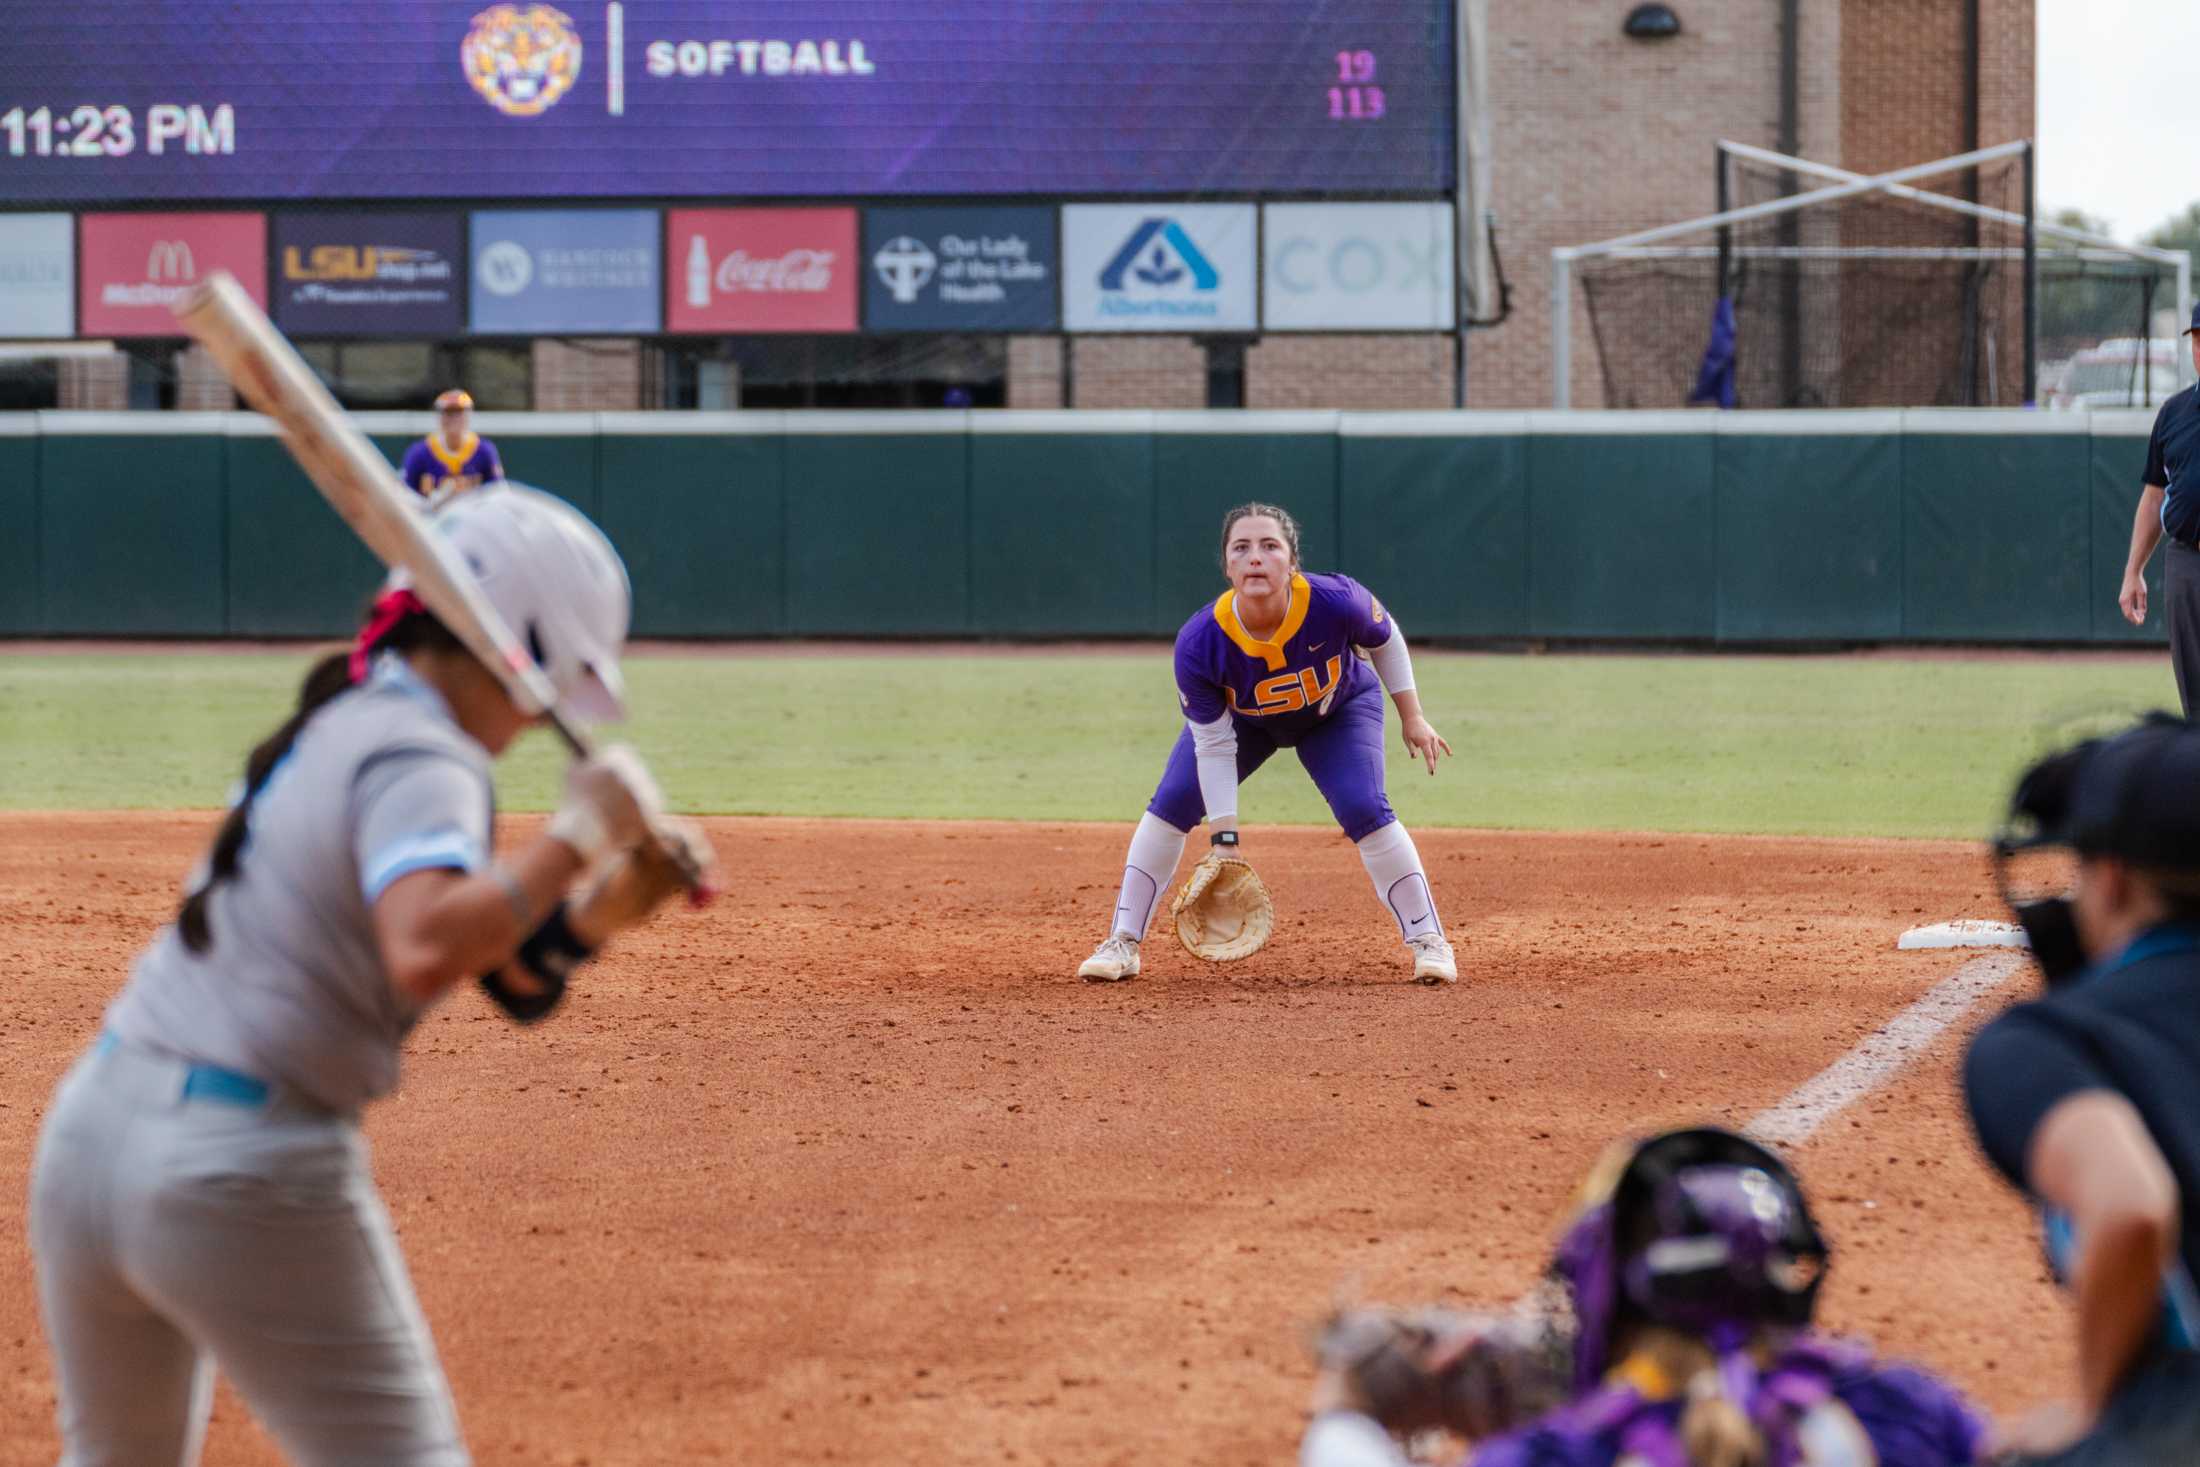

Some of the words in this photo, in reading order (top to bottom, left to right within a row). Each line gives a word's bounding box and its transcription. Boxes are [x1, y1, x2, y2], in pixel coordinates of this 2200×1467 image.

[645, 40, 876, 77] SOFTBALL
[1336, 49, 1376, 81] 19
[1327, 86, 1386, 118] 113
[0, 106, 135, 156] 11:23
[147, 104, 235, 155] PM
[940, 234, 978, 257] Our
[981, 234, 1028, 261] Lady
[1273, 236, 1442, 292] COX
[716, 248, 836, 292] Coca-Cola
[940, 258, 964, 280] of
[966, 258, 997, 280] the
[1000, 257, 1045, 280] Lake
[1225, 655, 1342, 716] LSU
